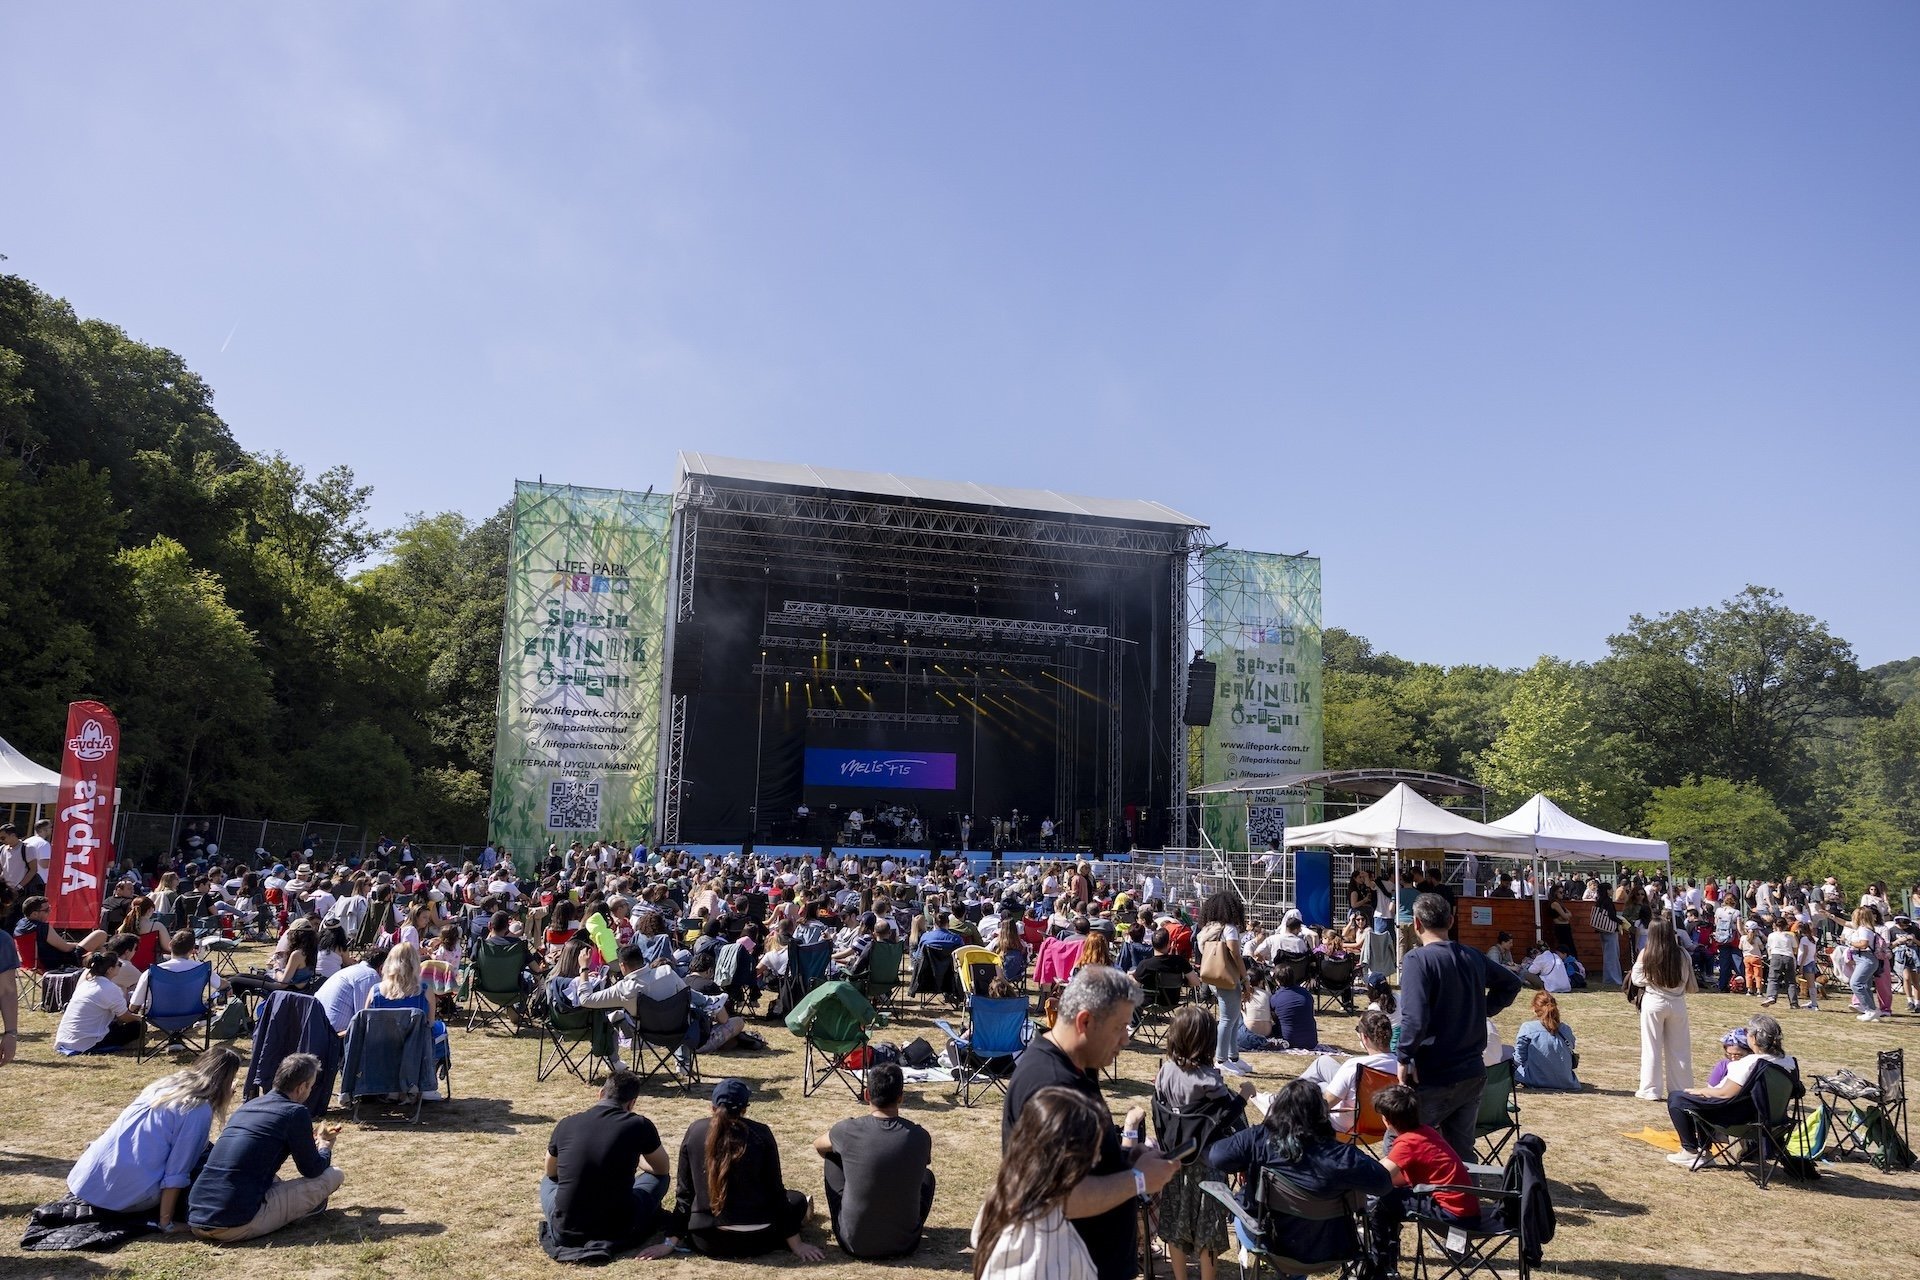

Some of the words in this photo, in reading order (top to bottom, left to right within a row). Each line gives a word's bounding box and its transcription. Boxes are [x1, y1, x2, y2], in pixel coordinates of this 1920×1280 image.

[555, 559, 587, 575] LIFE
[592, 562, 628, 577] PARK
[519, 706, 641, 719] www.lifepark.com.tr
[1220, 741, 1310, 752] www.lifepark.com.tr
[511, 759, 561, 768] LIFEPARK
[563, 760, 640, 771] UYGULAMASINI
